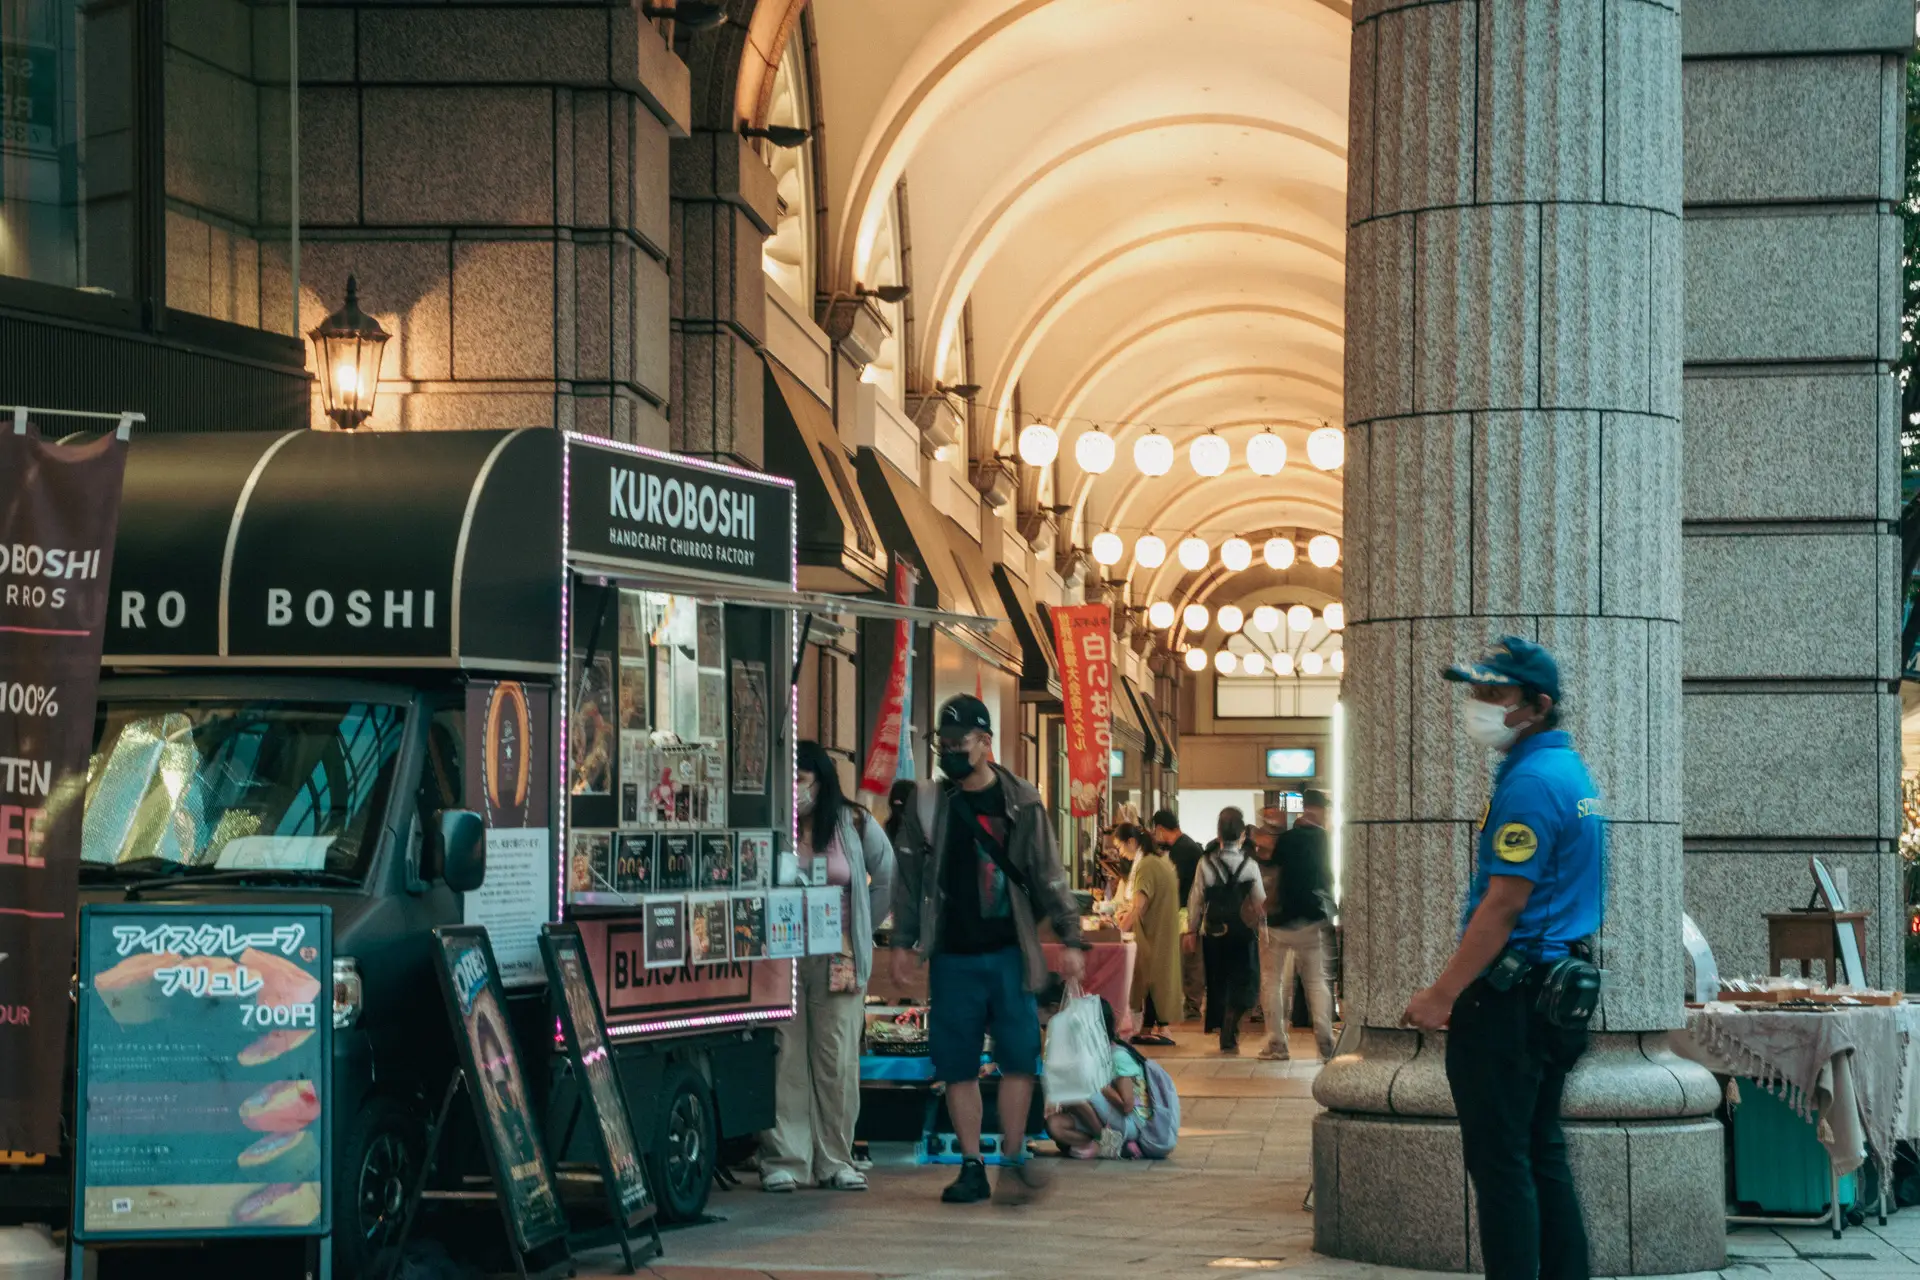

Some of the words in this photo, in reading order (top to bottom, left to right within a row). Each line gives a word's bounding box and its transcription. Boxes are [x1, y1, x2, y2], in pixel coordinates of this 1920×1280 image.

[610, 466, 755, 541] KUROBOSHI
[609, 527, 667, 552] HANDCRAFT
[670, 538, 713, 560] CHURROS
[716, 545, 755, 566] FACTORY
[267, 588, 436, 629] BOSHI
[0, 682, 58, 717] 100%
[0, 756, 52, 796] TEN
[113, 923, 305, 955] アイスクレープ
[154, 966, 264, 997] ブリュレ
[240, 1002, 316, 1027] 700円
